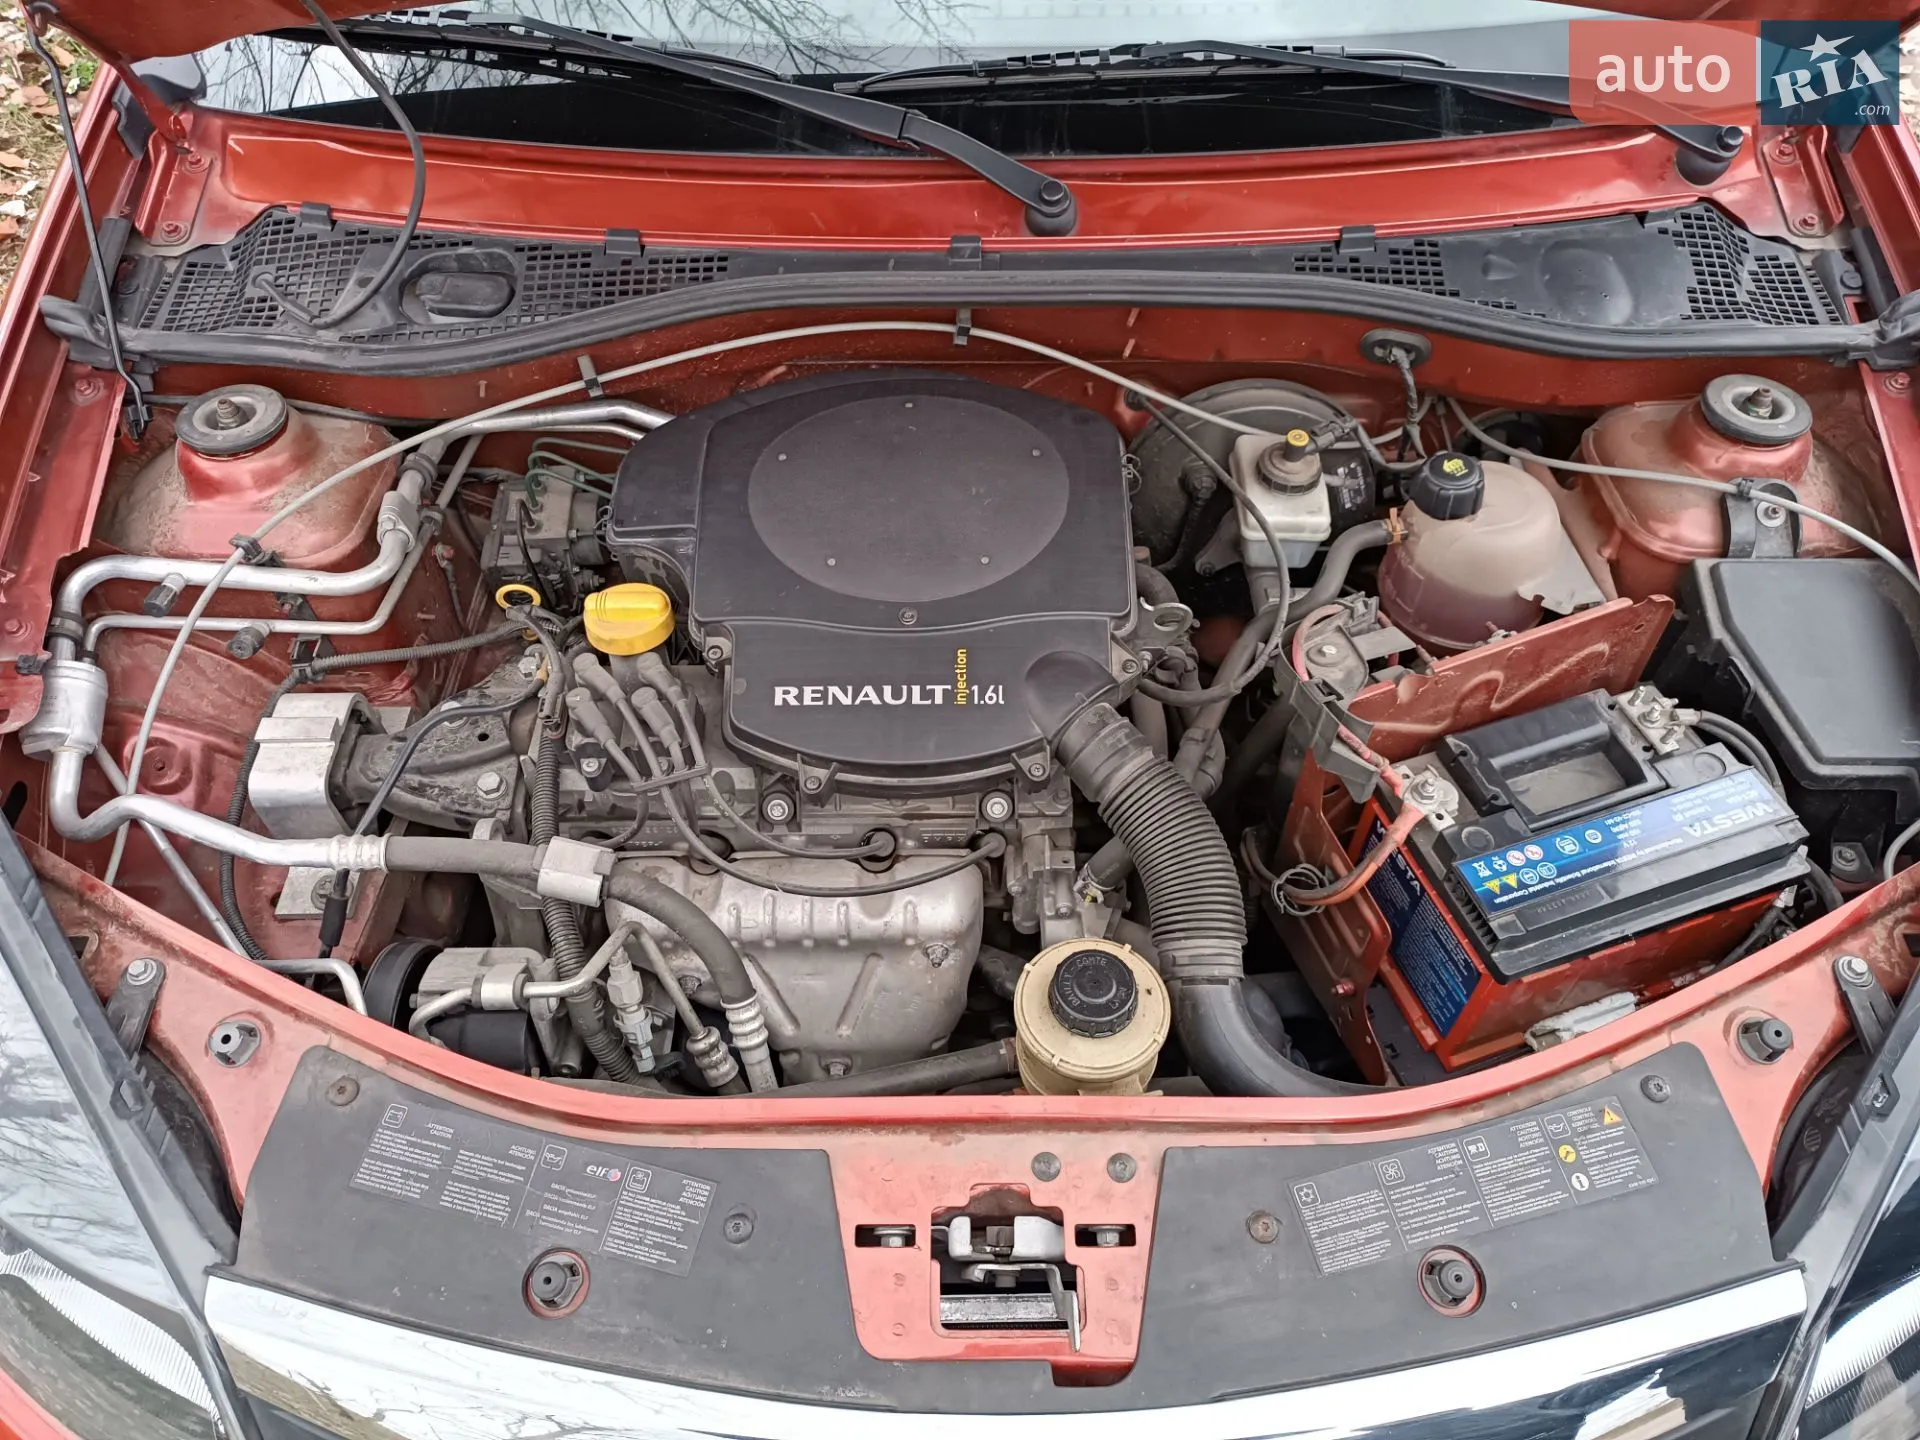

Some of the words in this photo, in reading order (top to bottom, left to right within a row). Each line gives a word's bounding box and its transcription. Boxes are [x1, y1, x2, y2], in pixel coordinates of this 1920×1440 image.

[954, 647, 969, 706] injection
[773, 684, 951, 707] RENAULT
[1681, 801, 1774, 841] WESTA
[1493, 888, 1529, 905] Corporation
[586, 1164, 610, 1177] elf
[685, 1185, 710, 1196] CAUTION
